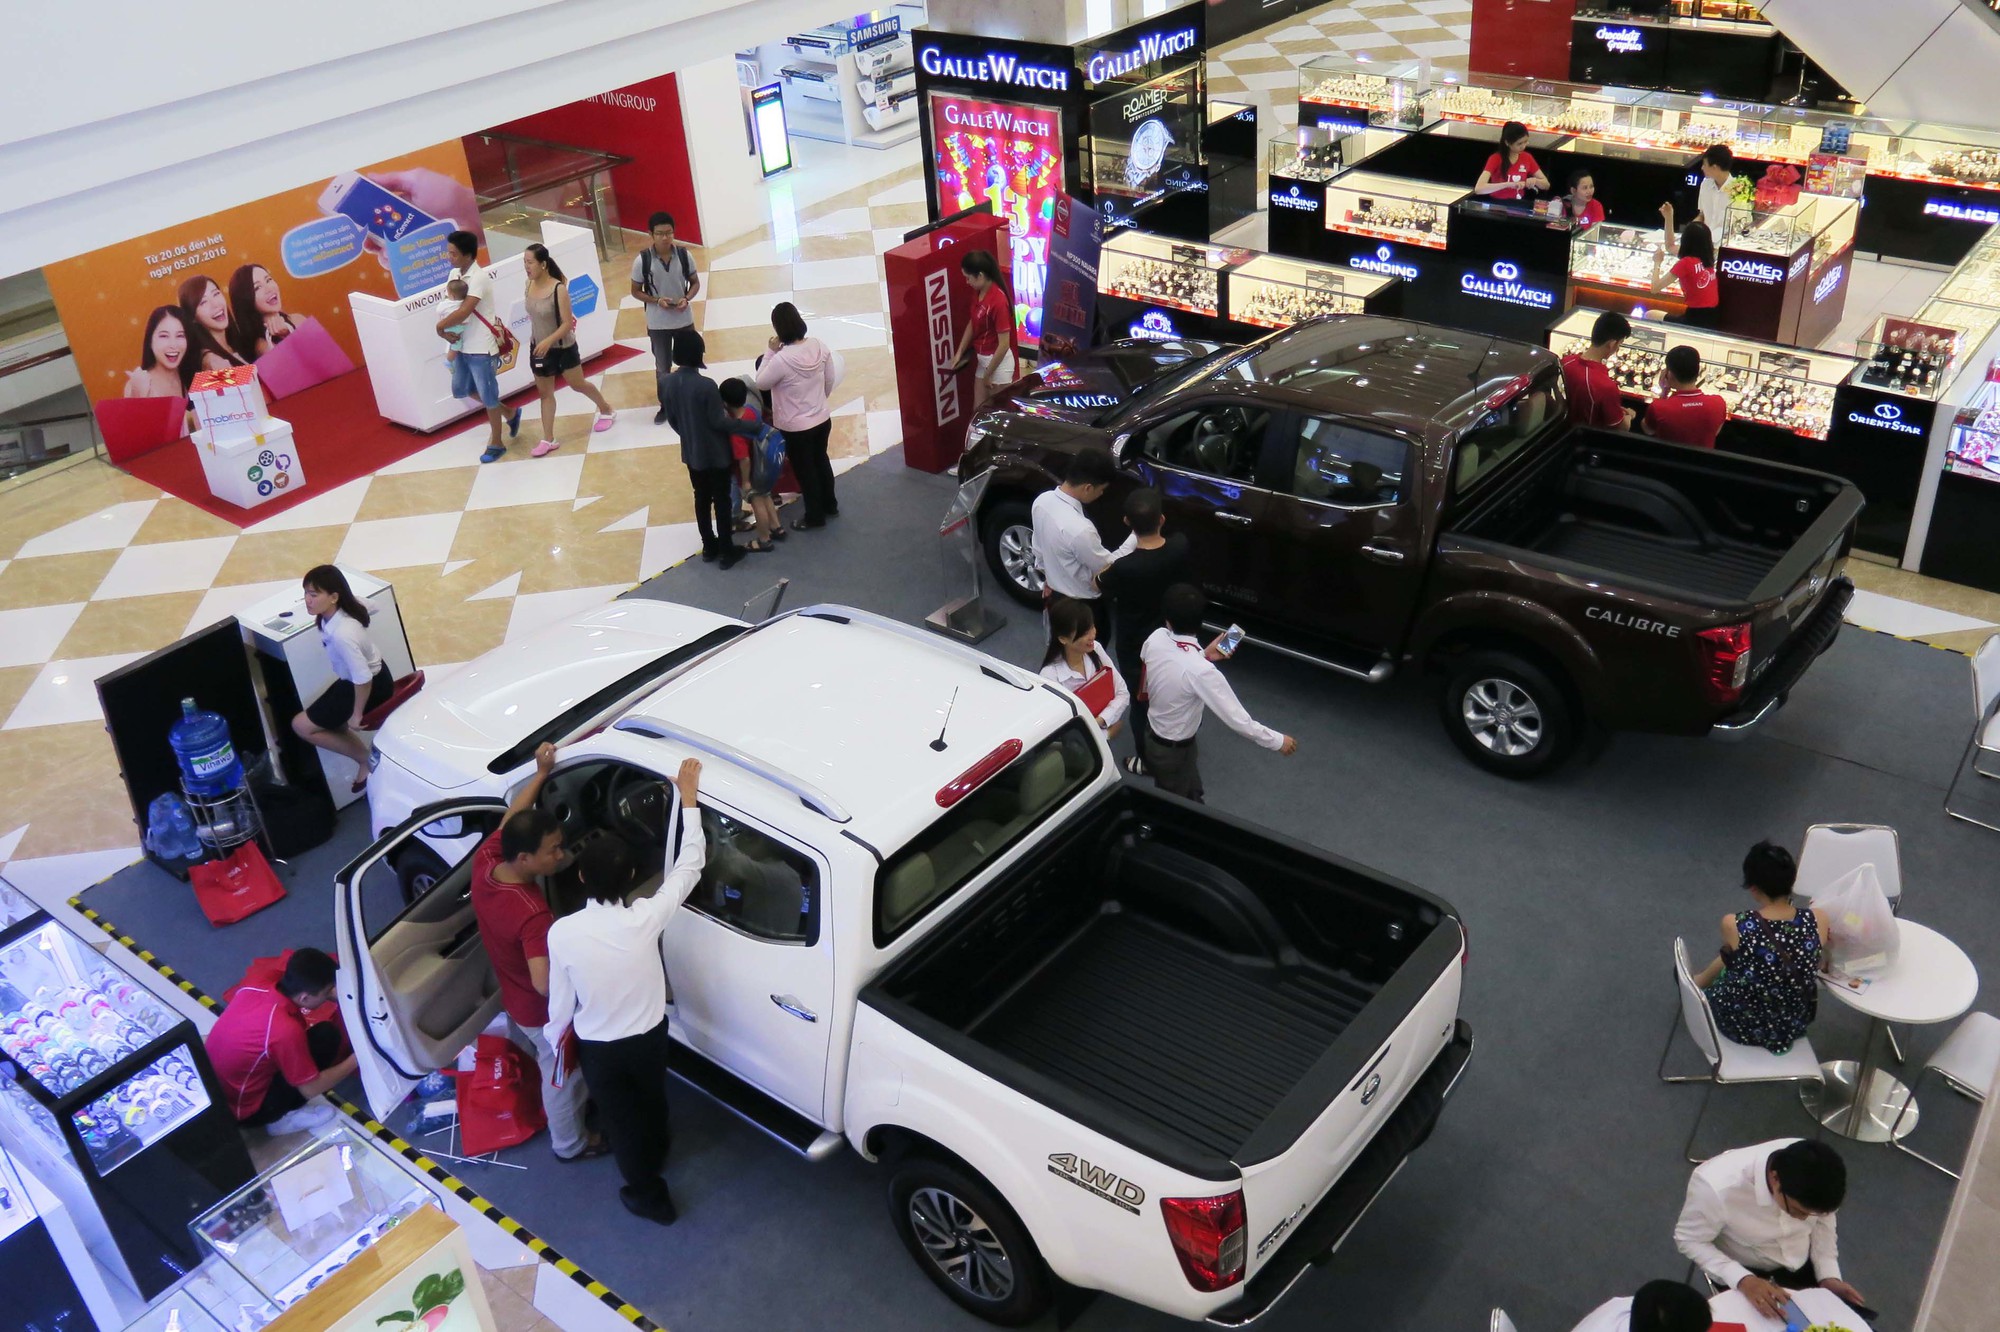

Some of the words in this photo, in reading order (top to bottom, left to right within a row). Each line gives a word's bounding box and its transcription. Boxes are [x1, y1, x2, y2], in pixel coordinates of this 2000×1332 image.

[850, 18, 898, 44] SAMSUNG
[1607, 40, 1643, 53] Graphics
[601, 92, 656, 112] VINGROUP
[1123, 88, 1168, 120] ROAMER
[1271, 193, 1318, 209] CANDINO
[1924, 203, 1999, 223] POLICE
[160, 245, 188, 261] 20.06
[173, 246, 227, 270] 05.07.2016
[1350, 257, 1418, 278] CANDINO
[1721, 259, 1783, 282] ROAMER
[405, 291, 442, 312] VINCOM
[929, 275, 956, 420] NISSAN
[202, 411, 255, 425] mobifone
[1585, 606, 1681, 638] CALIBRE
[1048, 1152, 1145, 1206] 4WD
